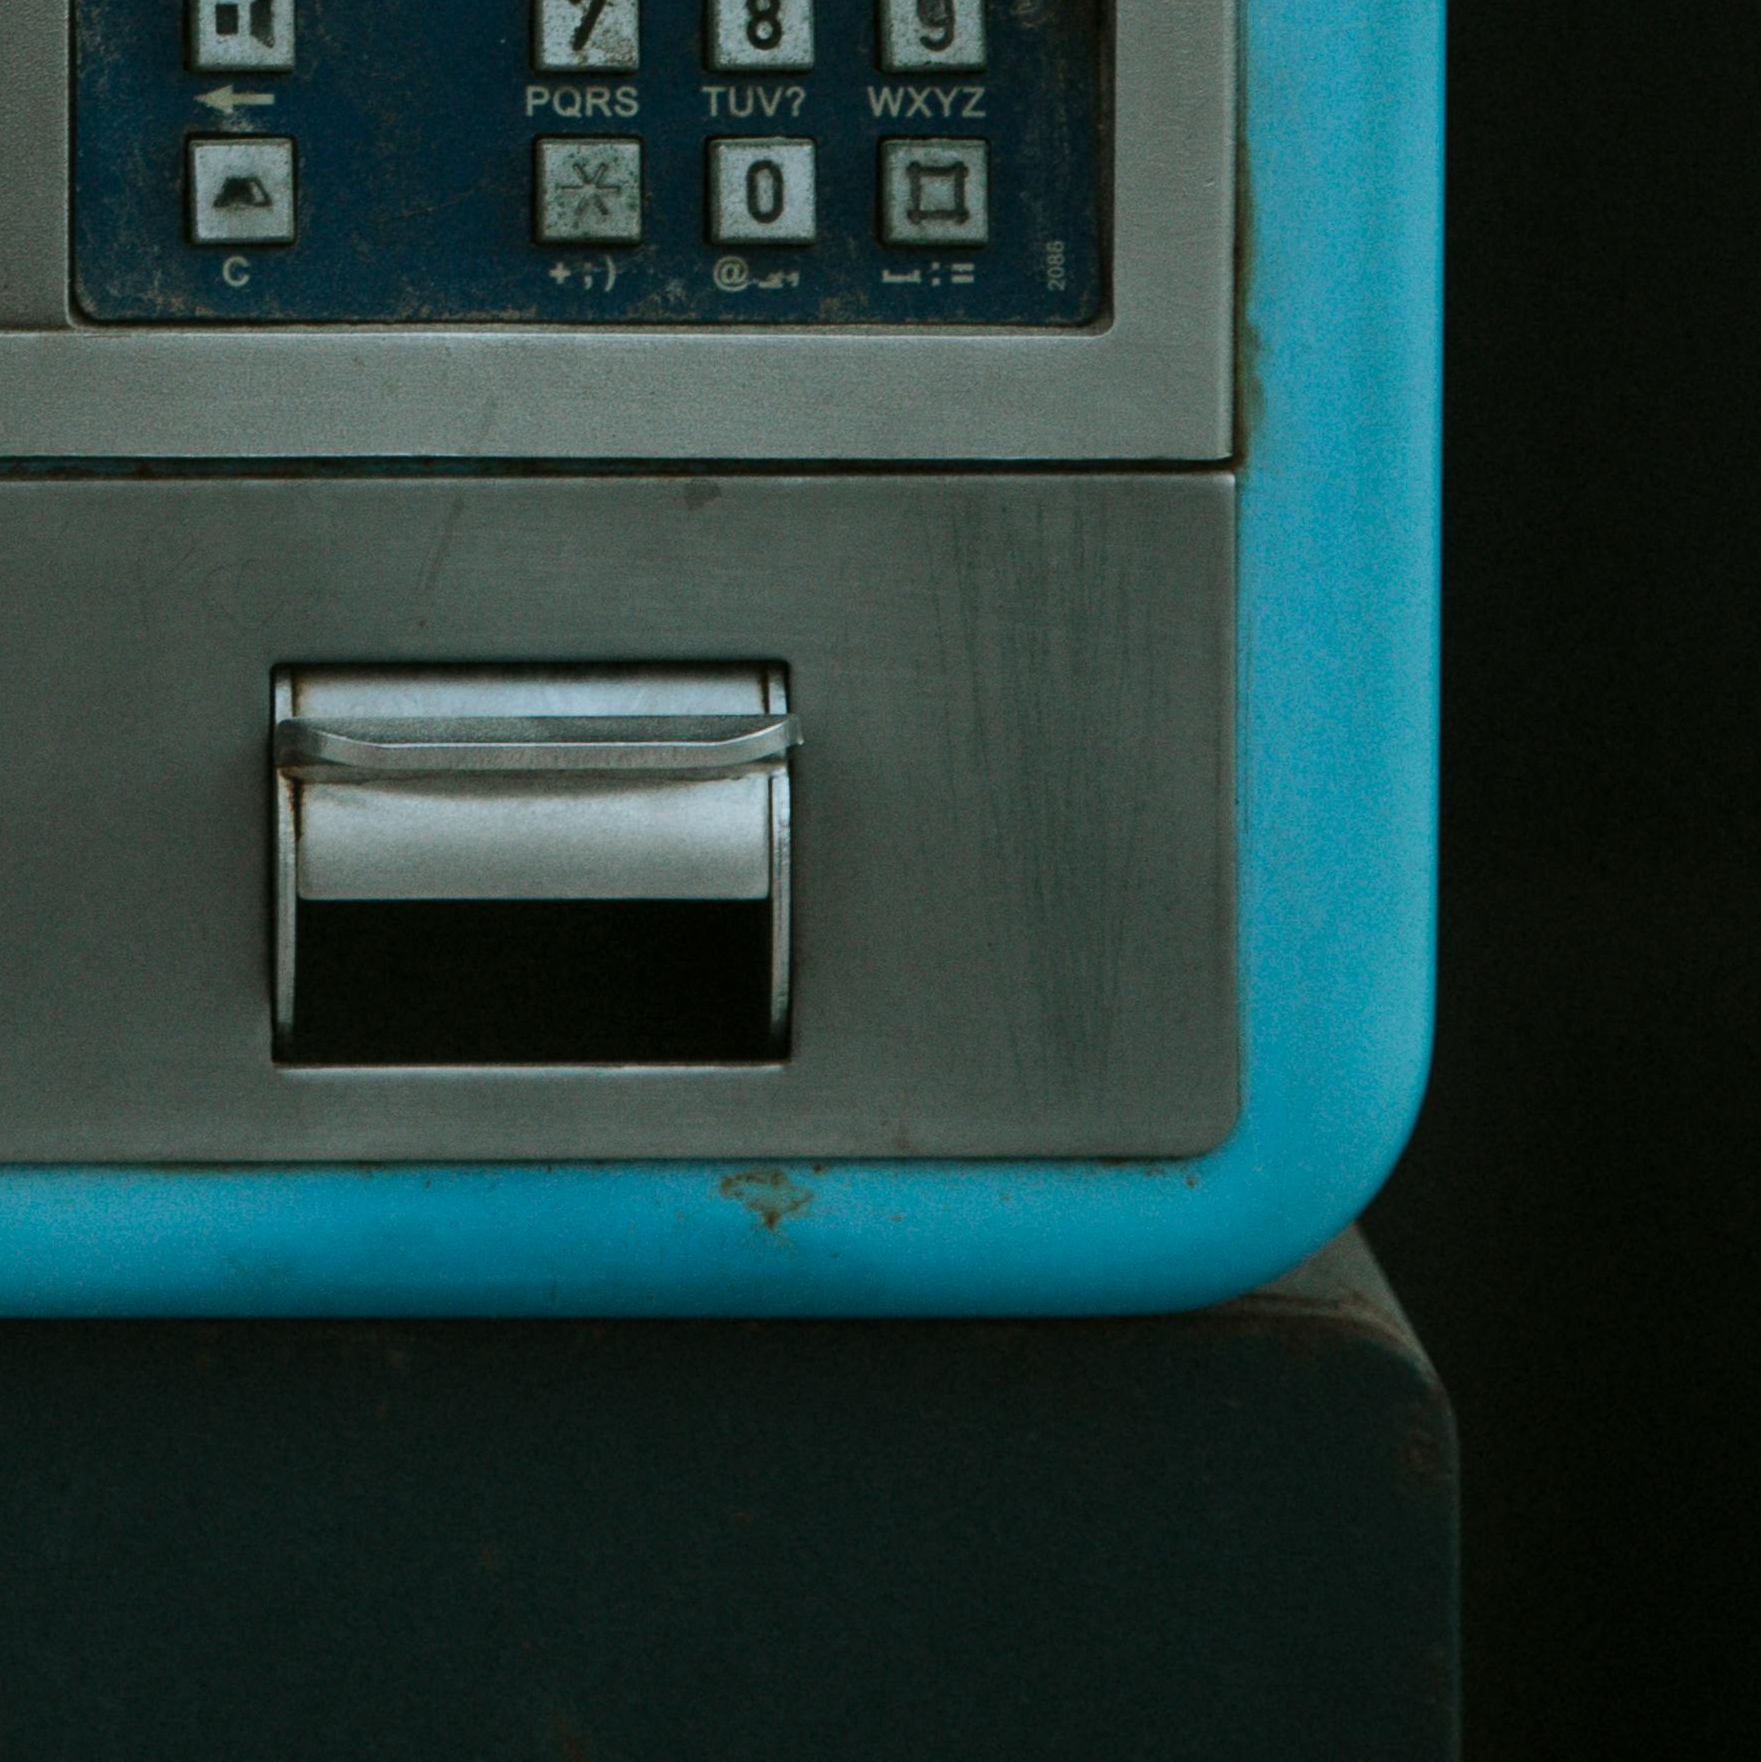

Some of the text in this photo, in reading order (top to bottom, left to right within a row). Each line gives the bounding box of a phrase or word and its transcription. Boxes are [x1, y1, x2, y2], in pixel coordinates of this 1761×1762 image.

[525, 85, 639, 118] PQRS
[701, 85, 806, 118] TUV?
[867, 86, 986, 118] WXYZ
[745, 158, 785, 225] 0
[222, 255, 250, 288] C
